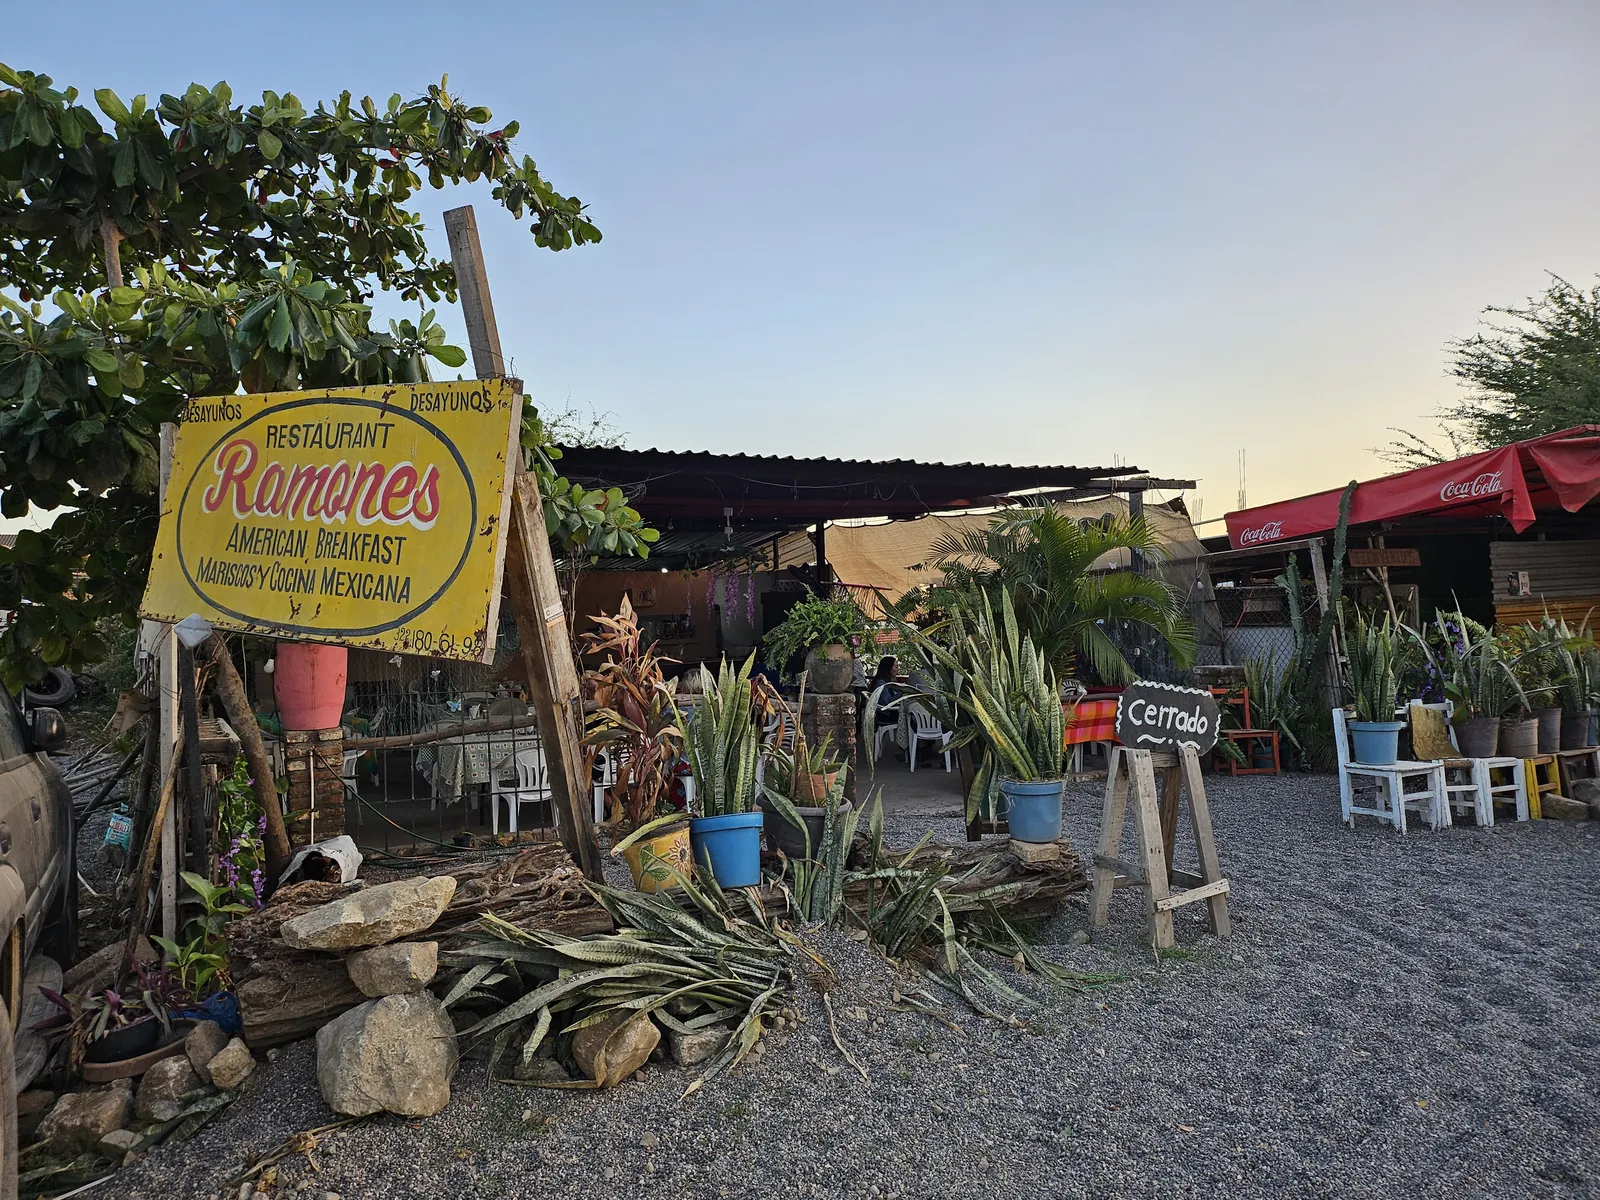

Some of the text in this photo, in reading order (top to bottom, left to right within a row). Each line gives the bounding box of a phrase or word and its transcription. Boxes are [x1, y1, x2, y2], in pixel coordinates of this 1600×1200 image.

[181, 403, 242, 423] DESAYUNOS
[410, 391, 493, 412] DESAYUNOS
[266, 422, 395, 449] RESTAURANT
[202, 438, 441, 531] Ramones
[1440, 470, 1503, 503] Coca-Cola
[225, 523, 407, 566] AMERICAN BREAKFAST
[1240, 519, 1284, 546] Coca-Cola
[195, 556, 411, 604] MARISCOS Y COCINA MEXICANA
[1127, 698, 1209, 735] Cerrado
